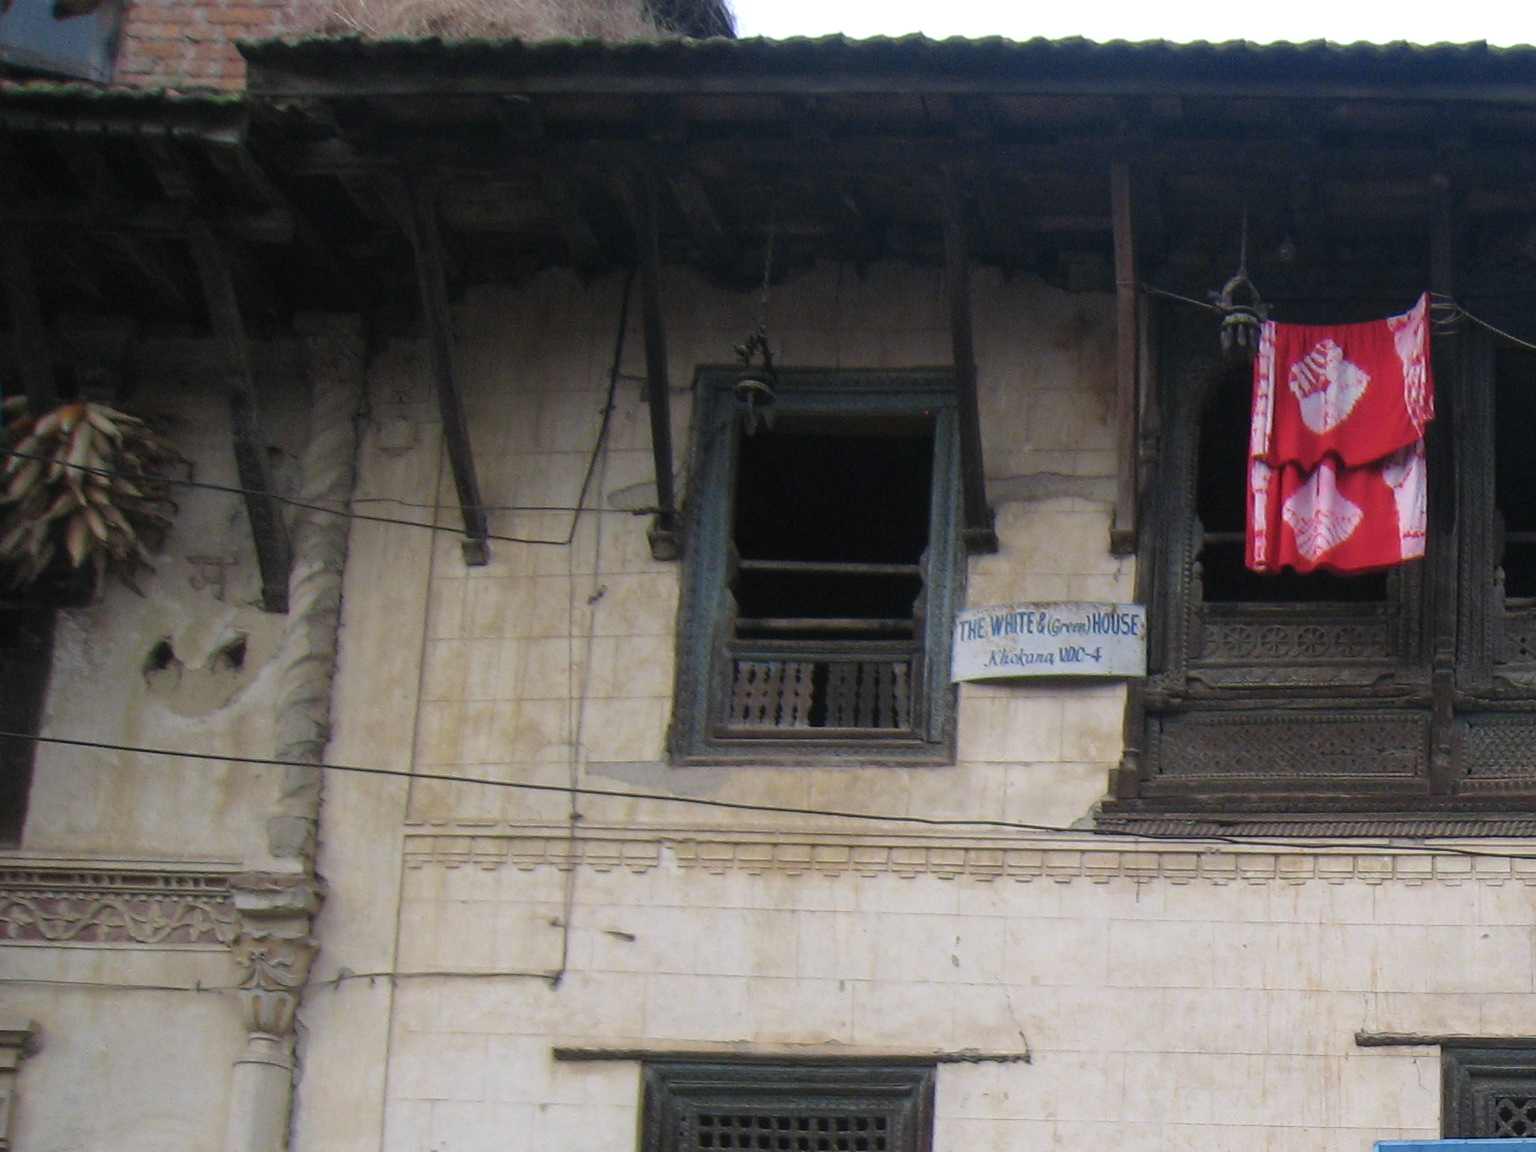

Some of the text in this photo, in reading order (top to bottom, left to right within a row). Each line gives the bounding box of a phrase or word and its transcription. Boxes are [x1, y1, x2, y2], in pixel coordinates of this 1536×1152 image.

[960, 617, 985, 641] THE
[990, 612, 1036, 636] WHITE
[1092, 612, 1140, 636] HOUSE
